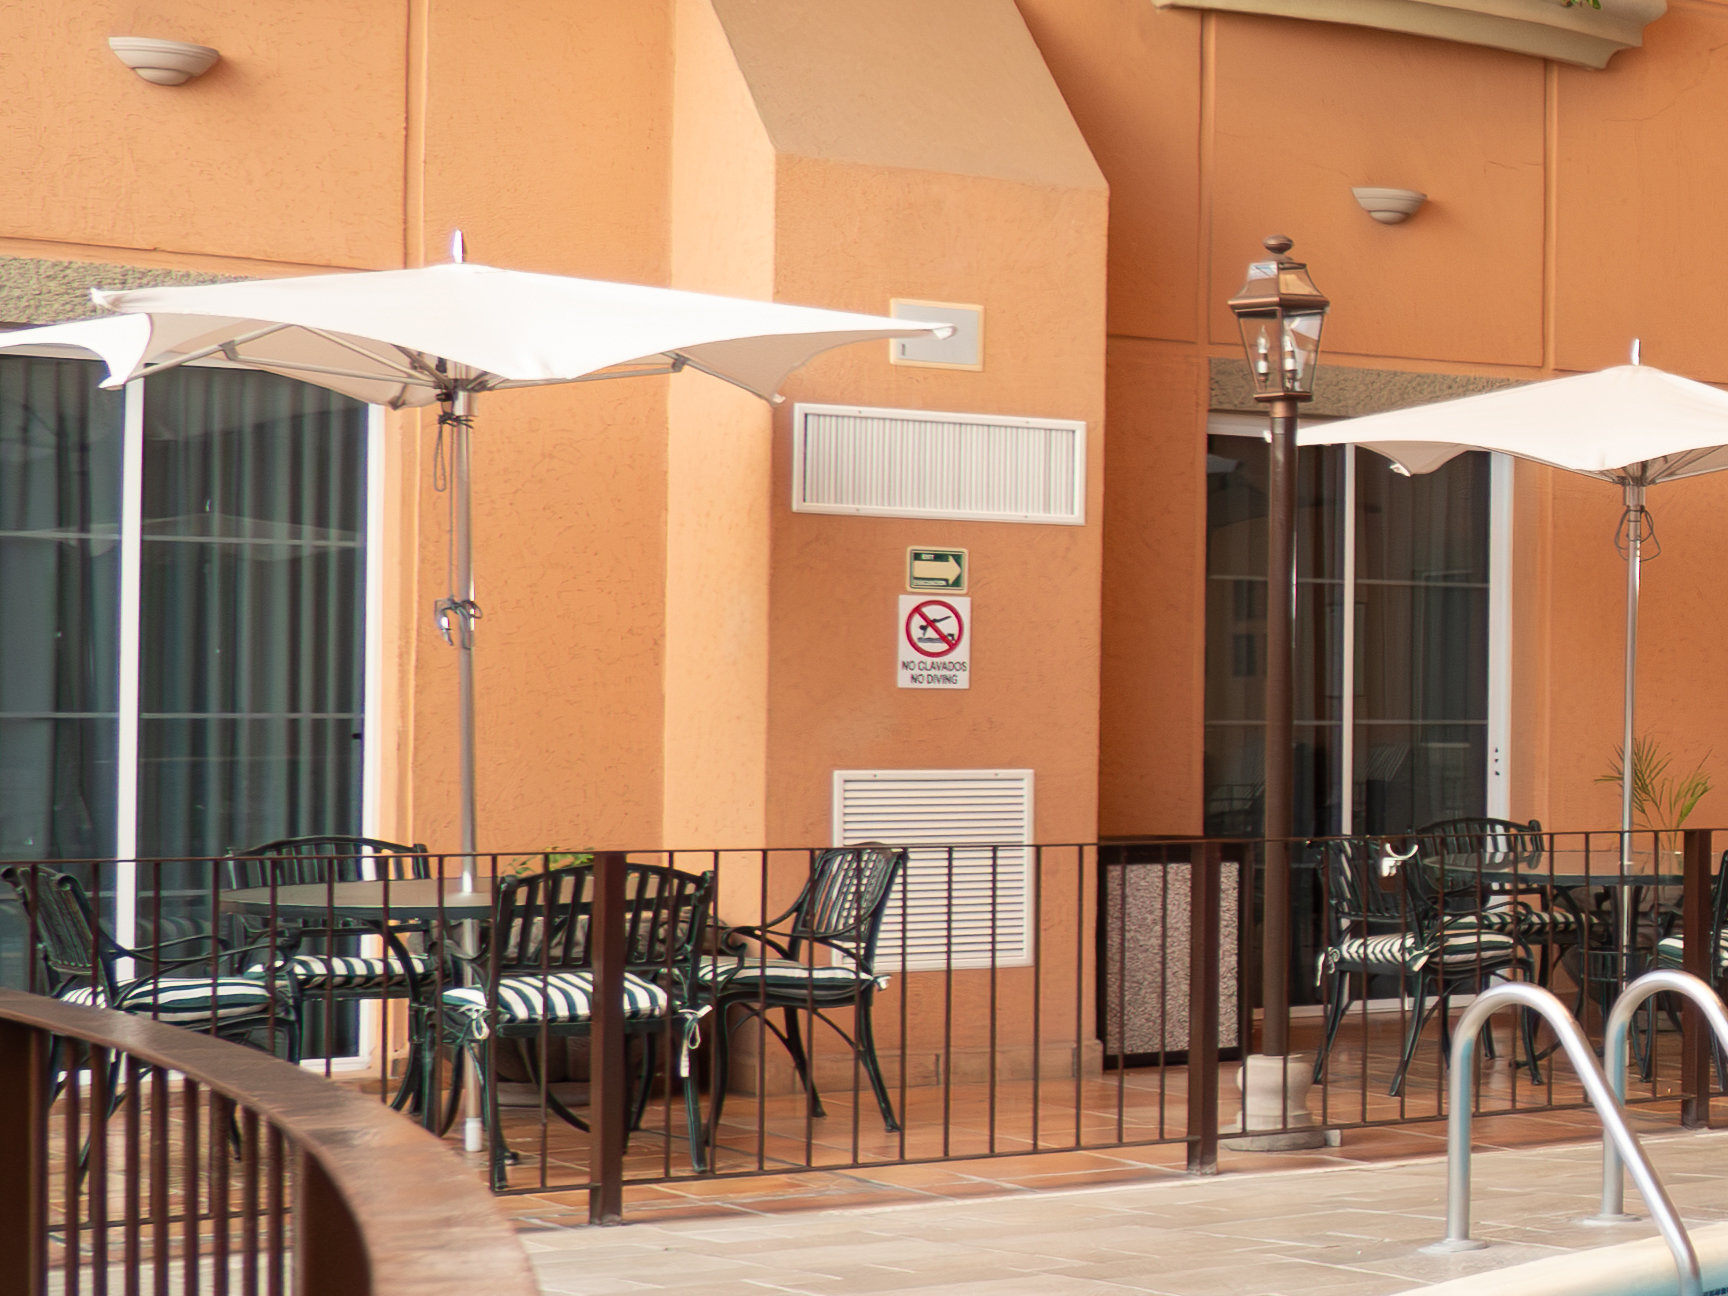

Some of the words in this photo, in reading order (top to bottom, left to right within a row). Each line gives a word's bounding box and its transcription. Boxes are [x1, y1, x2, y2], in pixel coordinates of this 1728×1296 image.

[902, 660, 916, 671] NO
[917, 660, 968, 672] CLAVADOS
[910, 673, 925, 684] NO
[926, 673, 959, 685] DIVING
